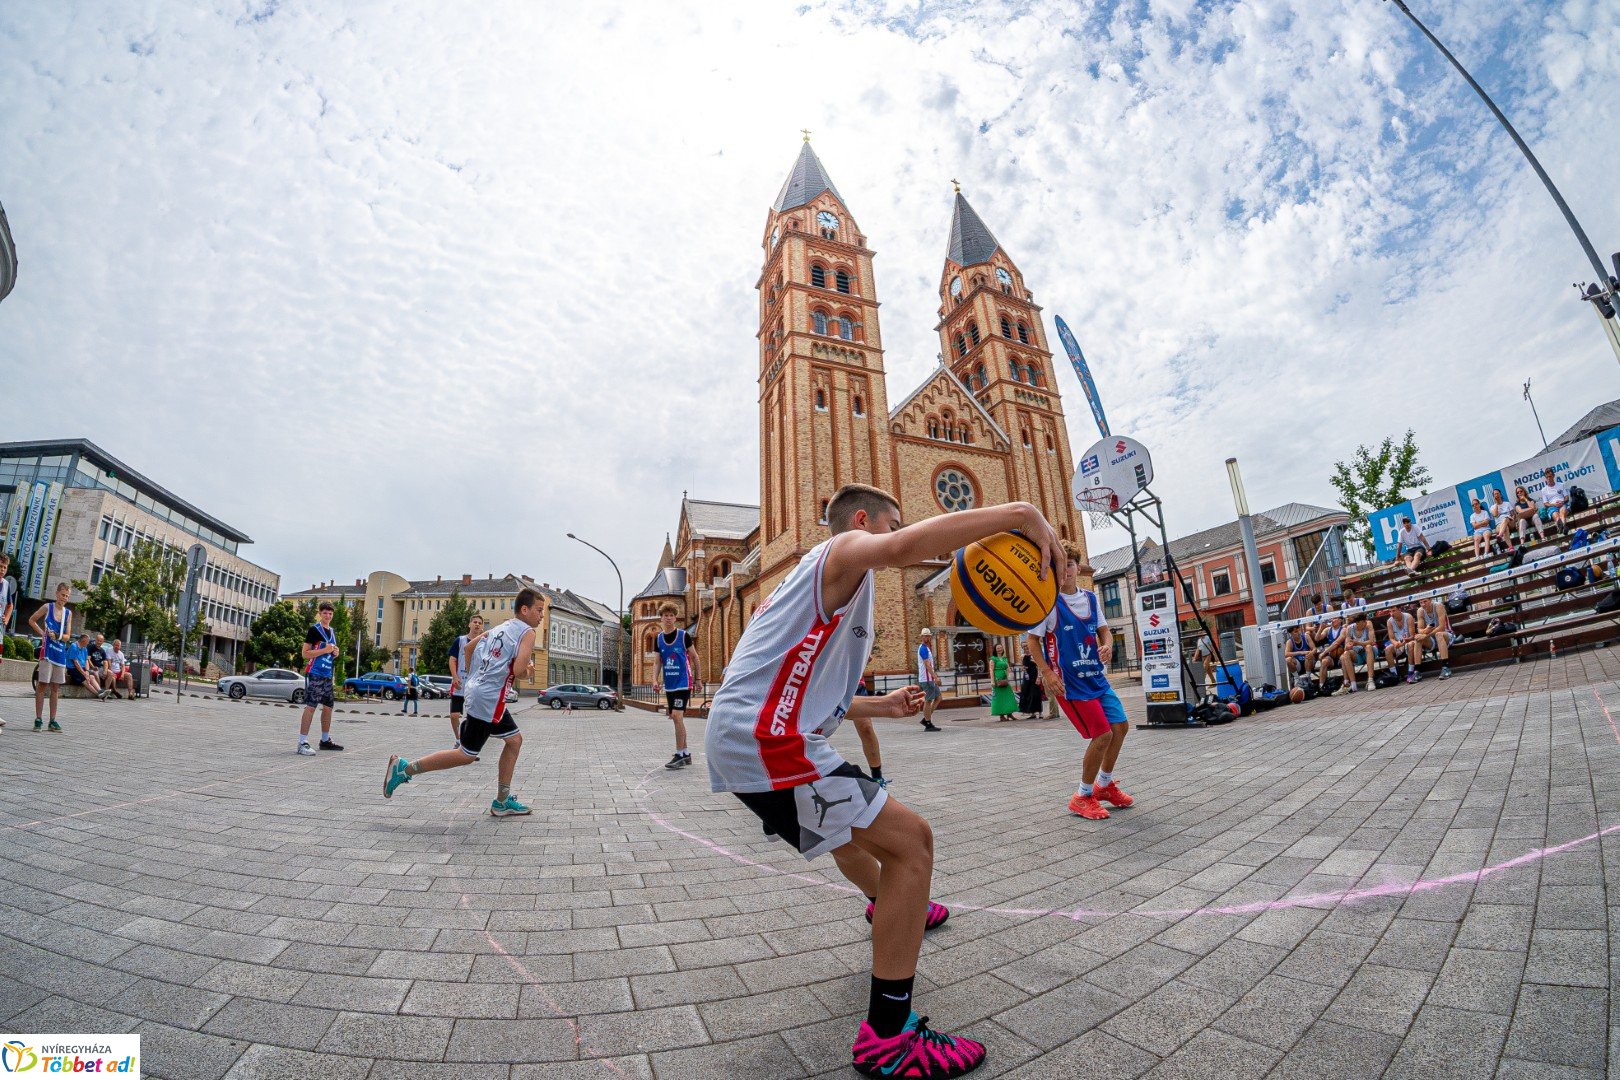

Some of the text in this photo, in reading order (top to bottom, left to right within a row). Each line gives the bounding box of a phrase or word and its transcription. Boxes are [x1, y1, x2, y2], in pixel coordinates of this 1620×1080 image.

[1111, 450, 1137, 466] SUZUKI
[1094, 476, 1100, 485] 8
[1514, 461, 1570, 486] MOZGÁBAN
[1418, 500, 1456, 516] MOZGÁSBAN
[41, 498, 58, 547] KÖNYVTÁR
[1420, 512, 1446, 523] TARTJUK
[1010, 545, 1030, 564] BALL
[975, 559, 1030, 613] molten
[1143, 628, 1170, 636] SUZUKI
